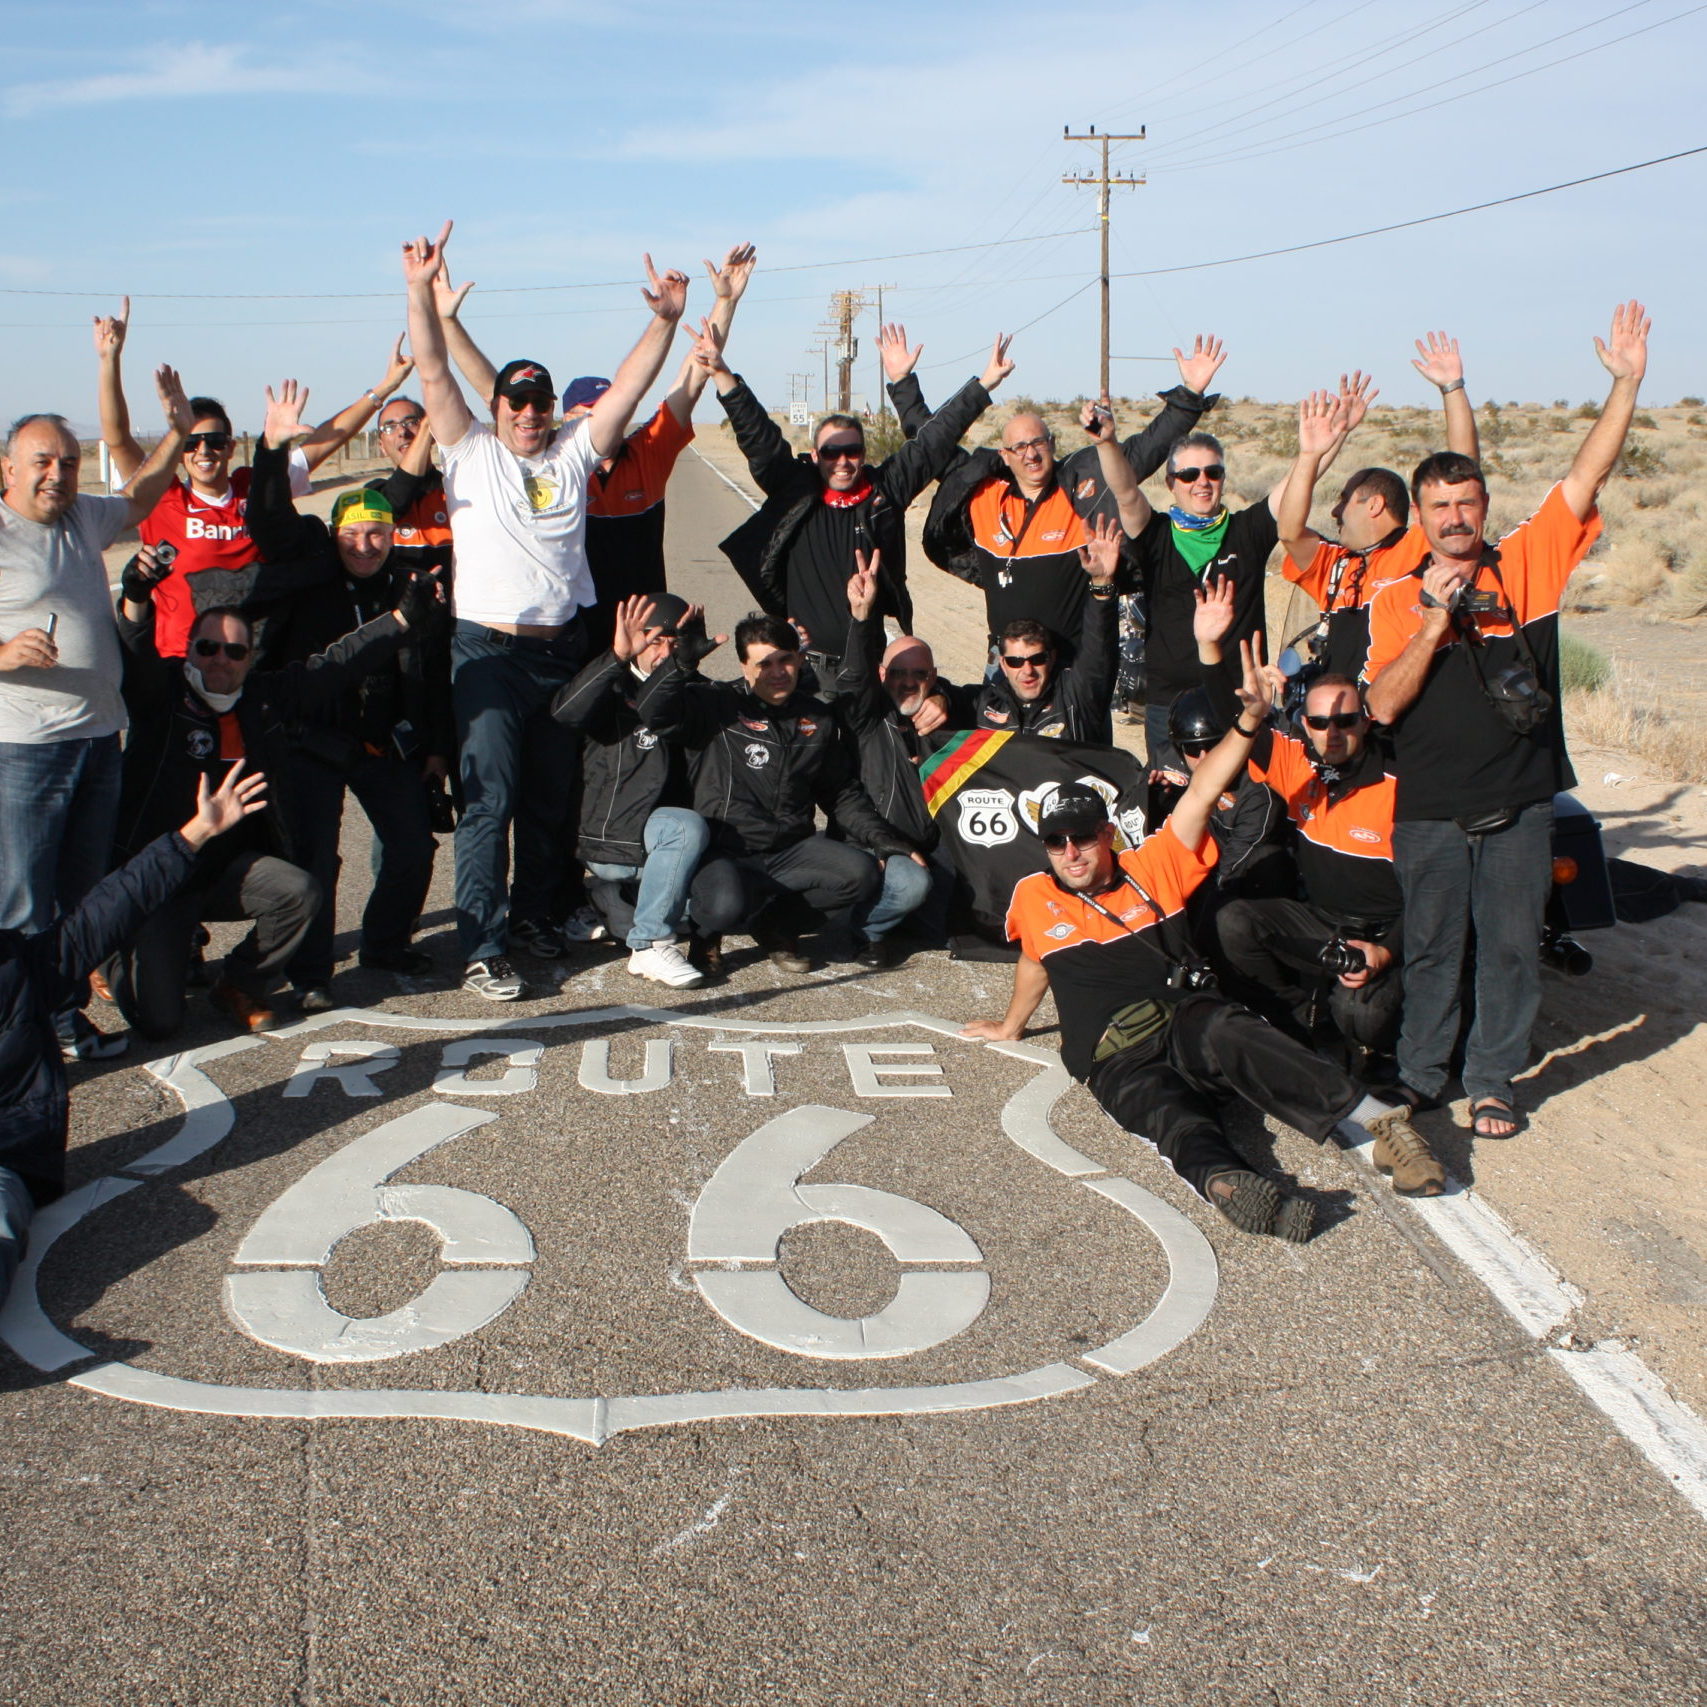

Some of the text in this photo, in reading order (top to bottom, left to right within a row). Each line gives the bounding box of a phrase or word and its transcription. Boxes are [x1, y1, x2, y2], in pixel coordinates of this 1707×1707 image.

[793, 414, 804, 423] 55
[967, 796, 1005, 805] ROUTE
[969, 811, 1008, 836] 66
[282, 1038, 953, 1098] ROUTE
[225, 1102, 992, 1362] 66
